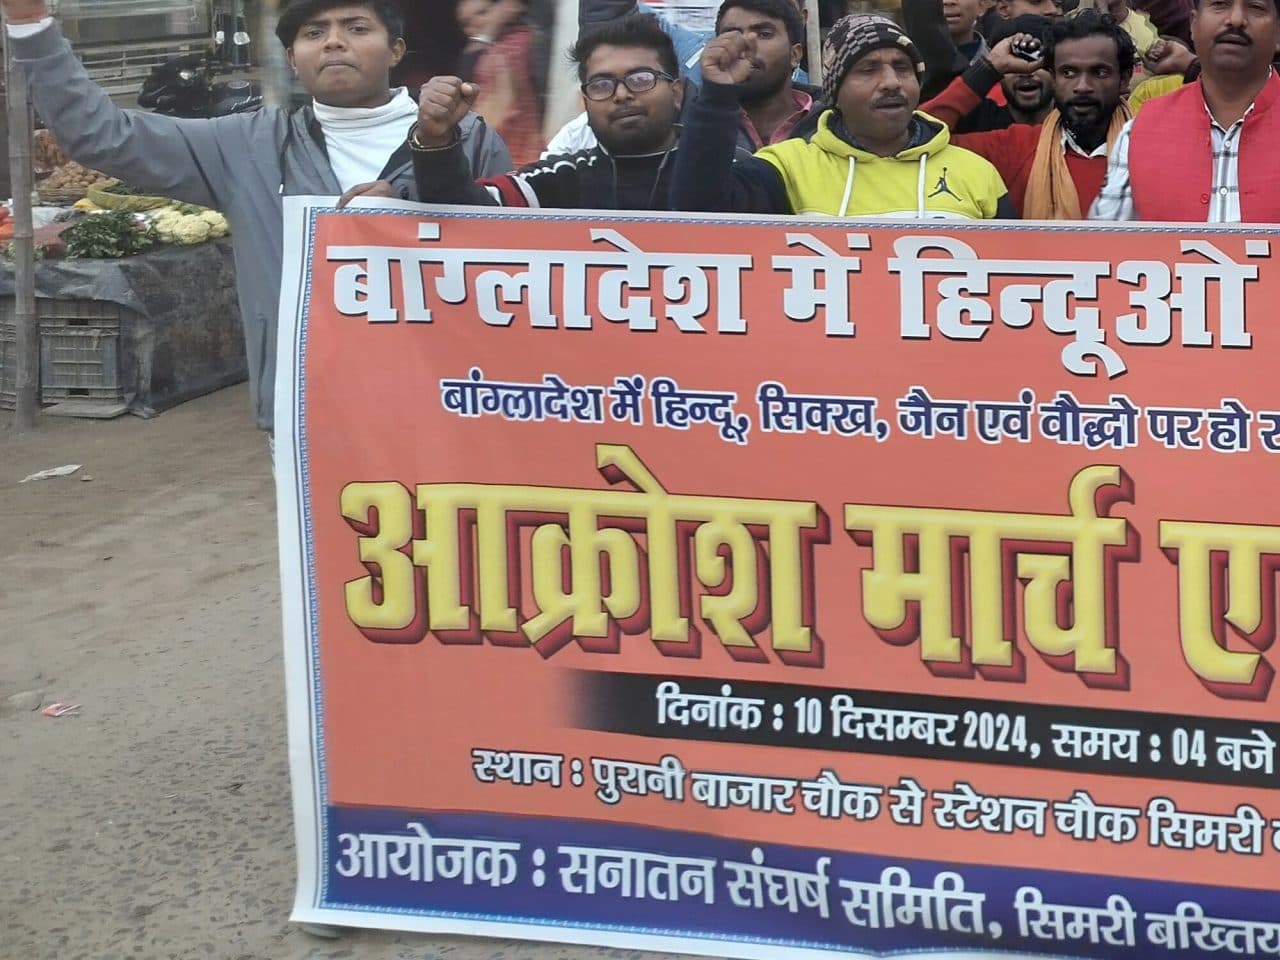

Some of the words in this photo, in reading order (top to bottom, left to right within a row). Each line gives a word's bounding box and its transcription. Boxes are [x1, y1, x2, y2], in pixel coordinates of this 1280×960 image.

[326, 222, 754, 334] बांग्लादेश
[772, 232, 871, 337] में
[887, 235, 1271, 378] हिन्दूओं
[440, 368, 605, 424] बांग्लादेश
[608, 374, 646, 425] में
[650, 377, 751, 445] हिन्दू,
[897, 386, 969, 439] जैन
[973, 388, 1035, 444] एवं
[1146, 407, 1203, 449] पर
[1206, 397, 1253, 453] हो
[340, 442, 825, 658] आक्रोश
[844, 464, 1134, 683] मार्च
[655, 681, 765, 730] दिनांक
[794, 697, 822, 734] 10
[831, 694, 959, 746] दिसम्बर
[963, 710, 1041, 759] 2024,
[1051, 724, 1140, 763] समय
[1172, 728, 1207, 767] 04
[1215, 729, 1276, 774] बजे
[473, 749, 563, 787] स्थान
[591, 755, 685, 803] पुरानी
[691, 772, 798, 814] बाजार
[801, 770, 884, 819] चौक
[889, 779, 926, 824] से
[933, 783, 1049, 836] स्टेशन
[1054, 792, 1140, 842] चौक
[1147, 798, 1265, 854] सिमरी
[335, 822, 521, 887] आयोजक
[558, 846, 716, 904] सनातन
[723, 847, 831, 918] संघर्ष
[839, 866, 1002, 938] समिति,
[1015, 886, 1137, 948] सिमरी
